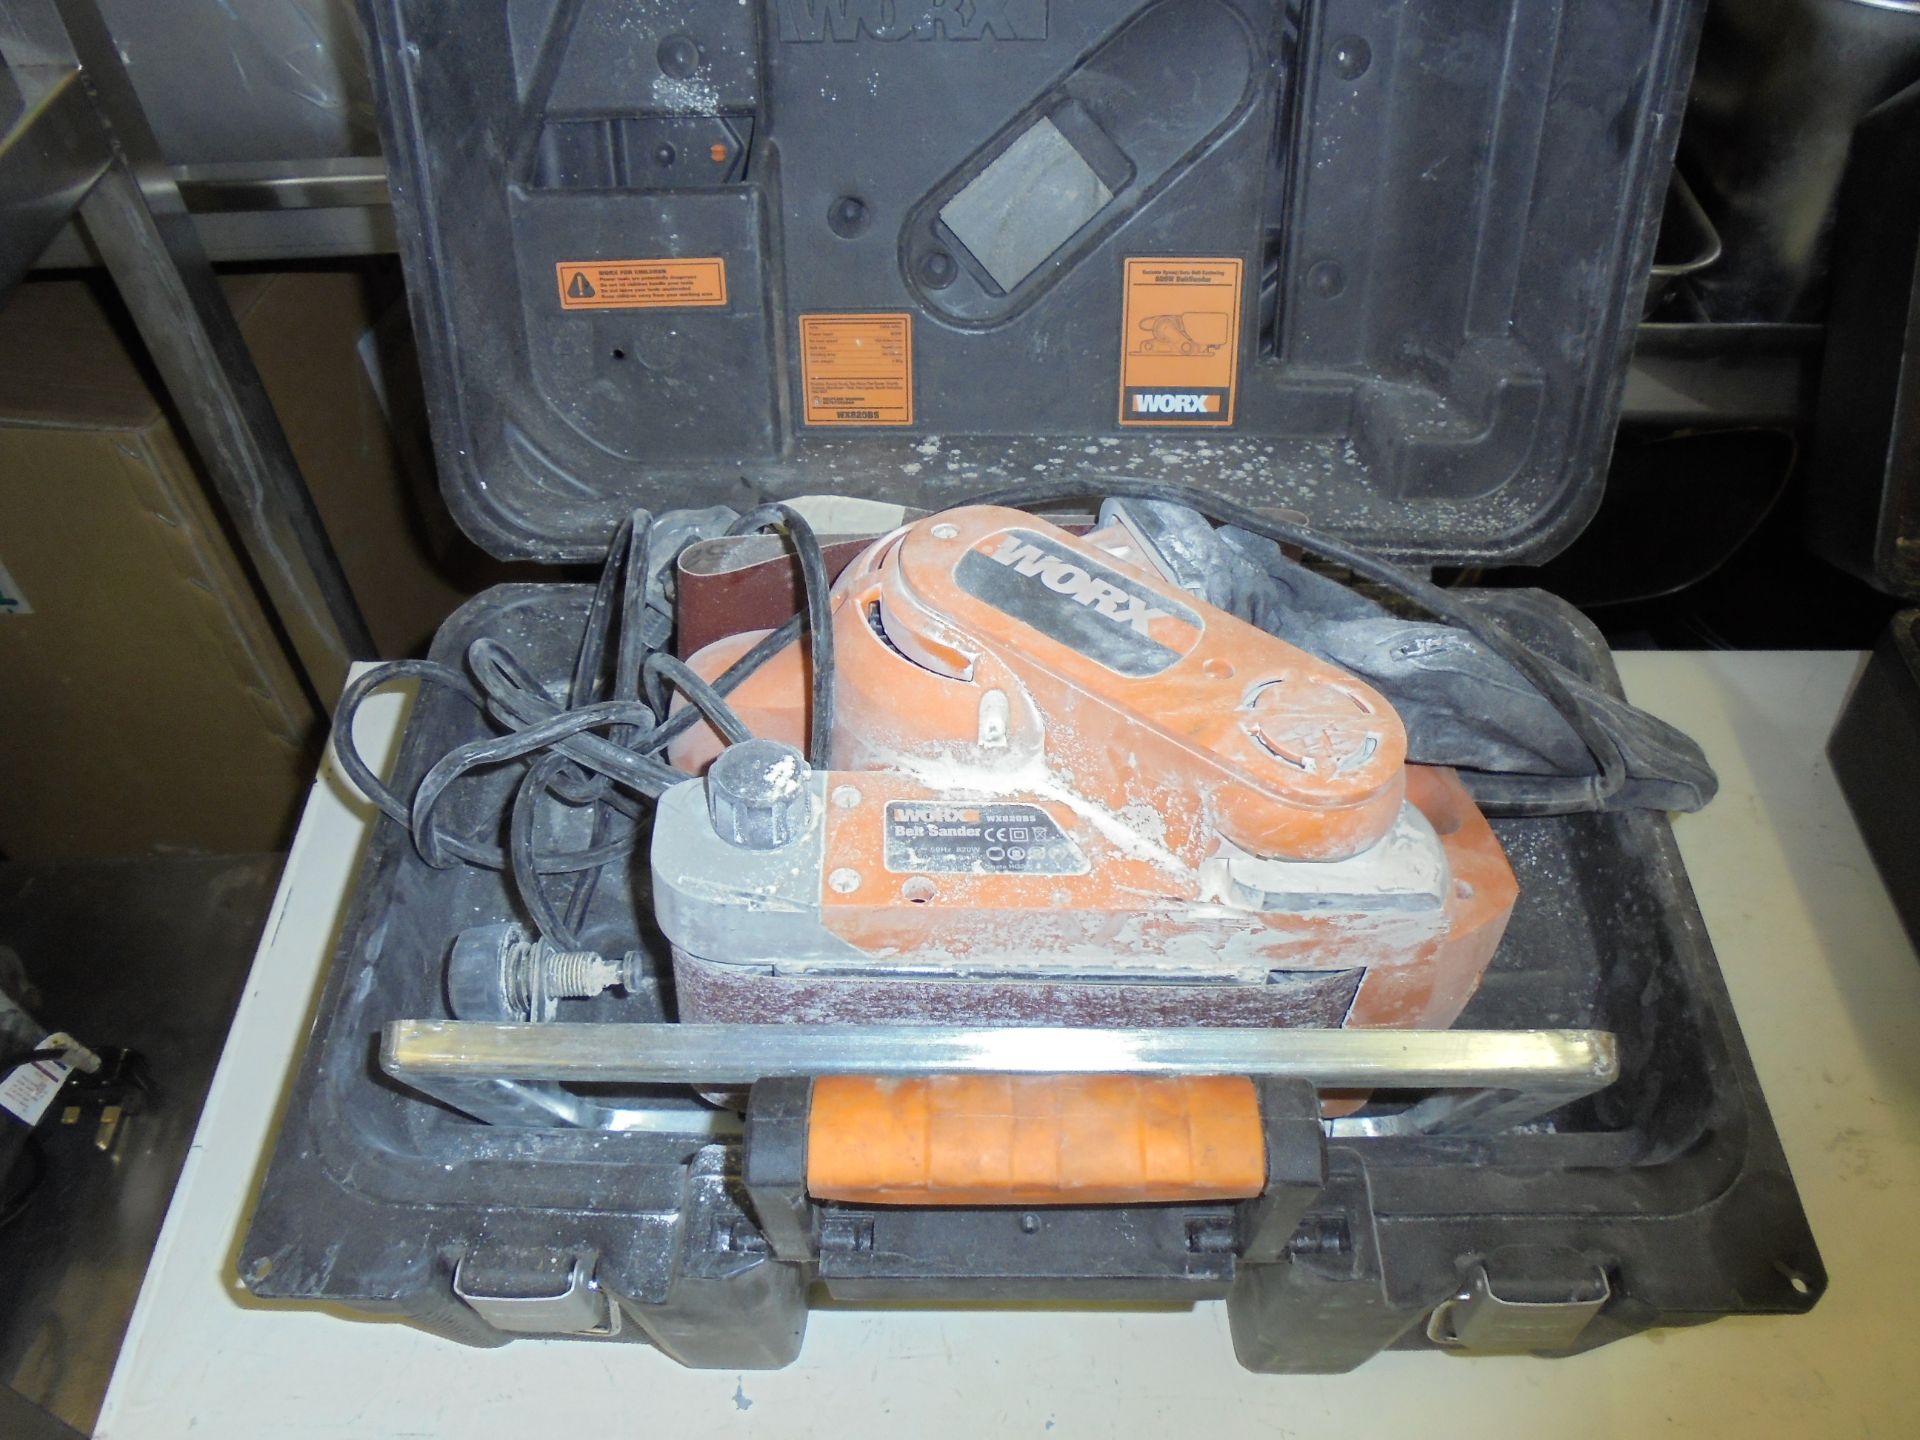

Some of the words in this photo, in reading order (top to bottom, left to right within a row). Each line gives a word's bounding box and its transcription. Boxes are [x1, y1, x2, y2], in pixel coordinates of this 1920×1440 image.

[1135, 394, 1209, 413] WORX
[989, 533, 1173, 638] WORX
[895, 808, 969, 823] WORX
[894, 825, 924, 838] Belt
[926, 824, 981, 837] Sander
